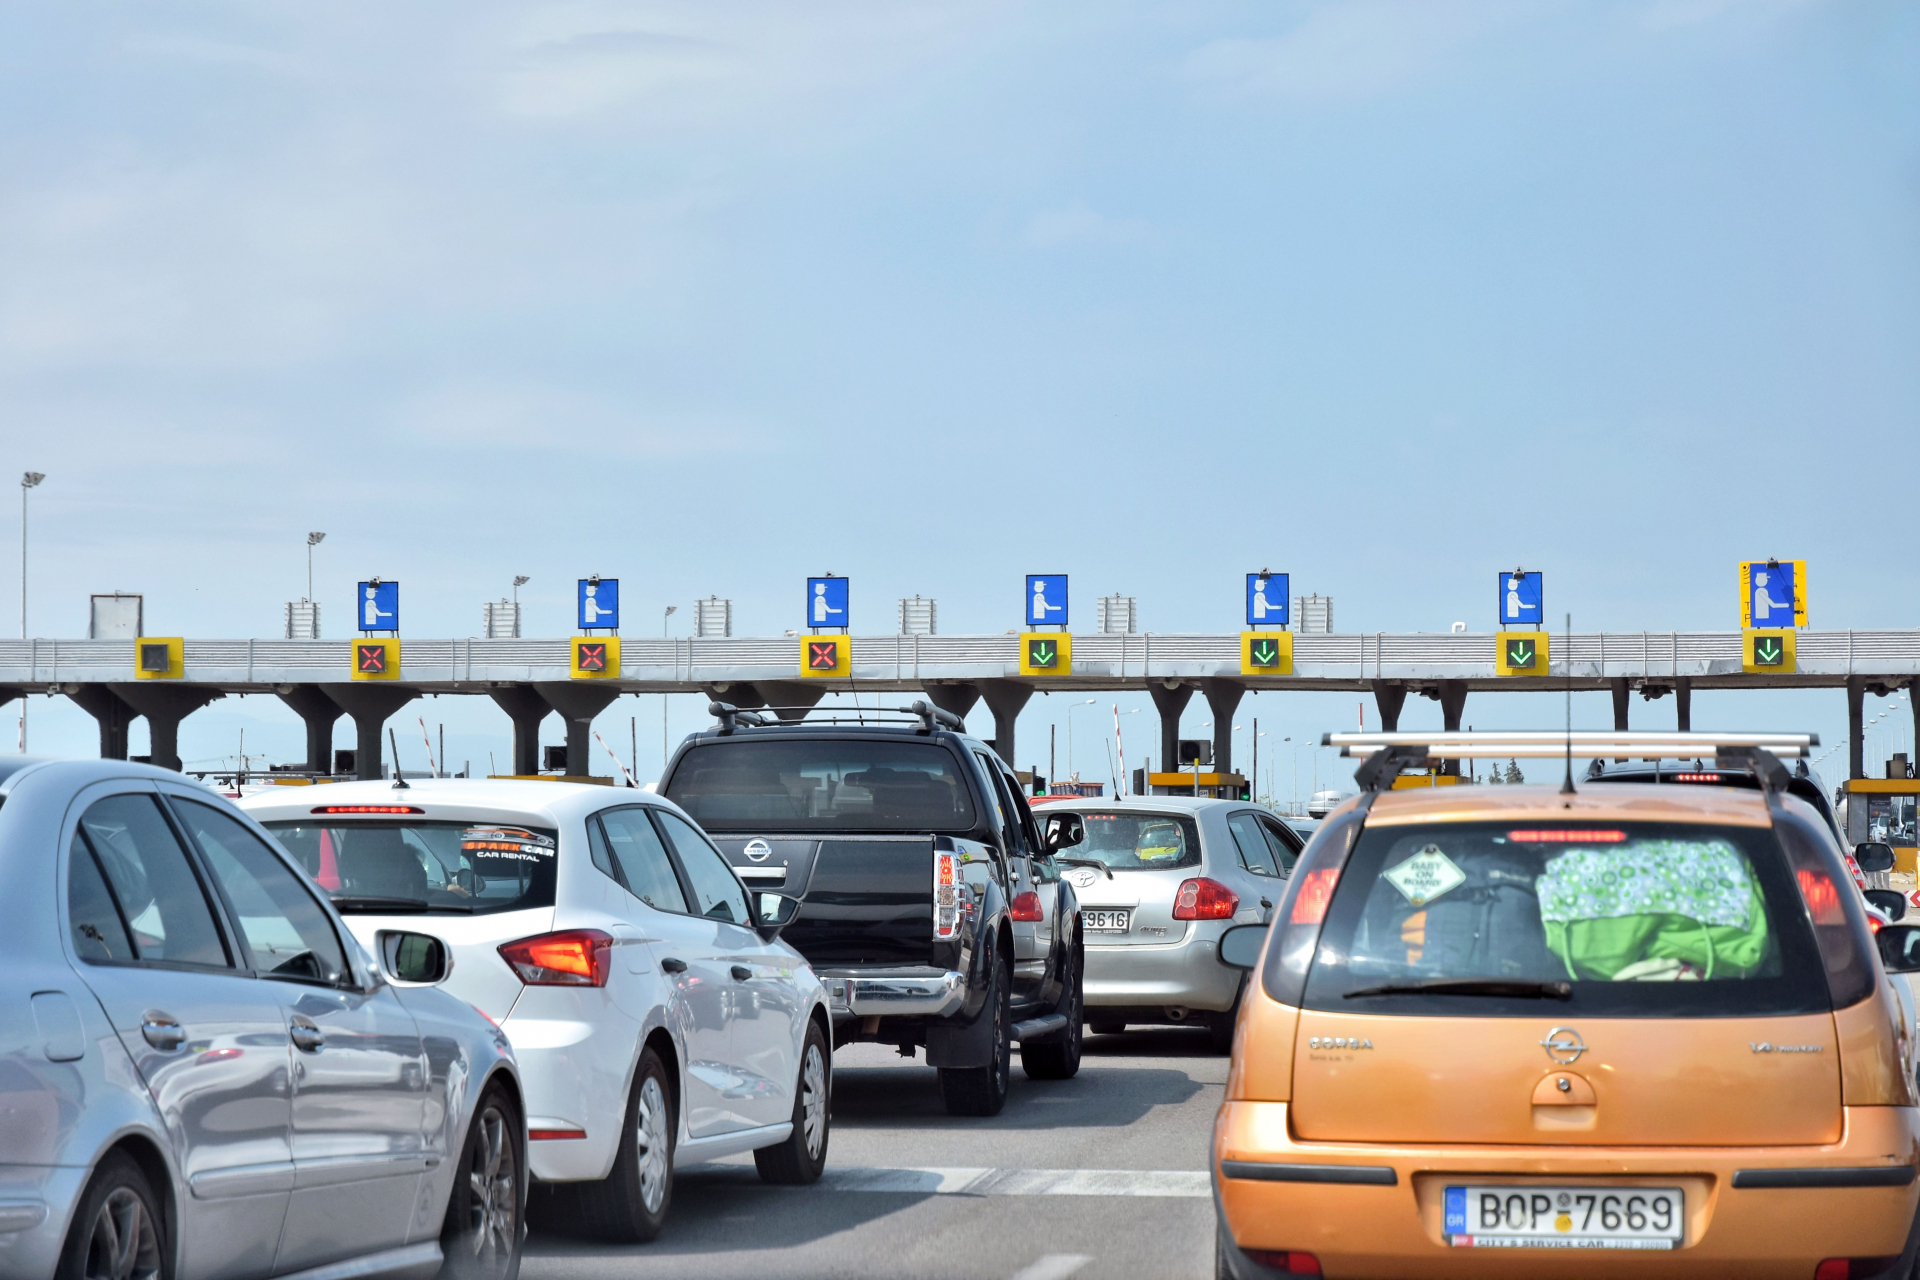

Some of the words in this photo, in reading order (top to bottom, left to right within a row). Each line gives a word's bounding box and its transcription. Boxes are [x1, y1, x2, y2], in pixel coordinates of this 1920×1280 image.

[466, 841, 520, 851] SPARK
[525, 845, 555, 857] CAR
[501, 852, 540, 862] RENTAL
[1411, 862, 1442, 871] BABY
[1416, 870, 1434, 879] ON
[1087, 912, 1126, 928] 9616
[1309, 1036, 1374, 1050] CORSA
[1479, 1192, 1552, 1231] BOP
[1575, 1194, 1673, 1232] 7669
[1446, 1215, 1465, 1228] GR
[1522, 1239, 1573, 1249] SERVICE
[1577, 1240, 1605, 1249] CAR
